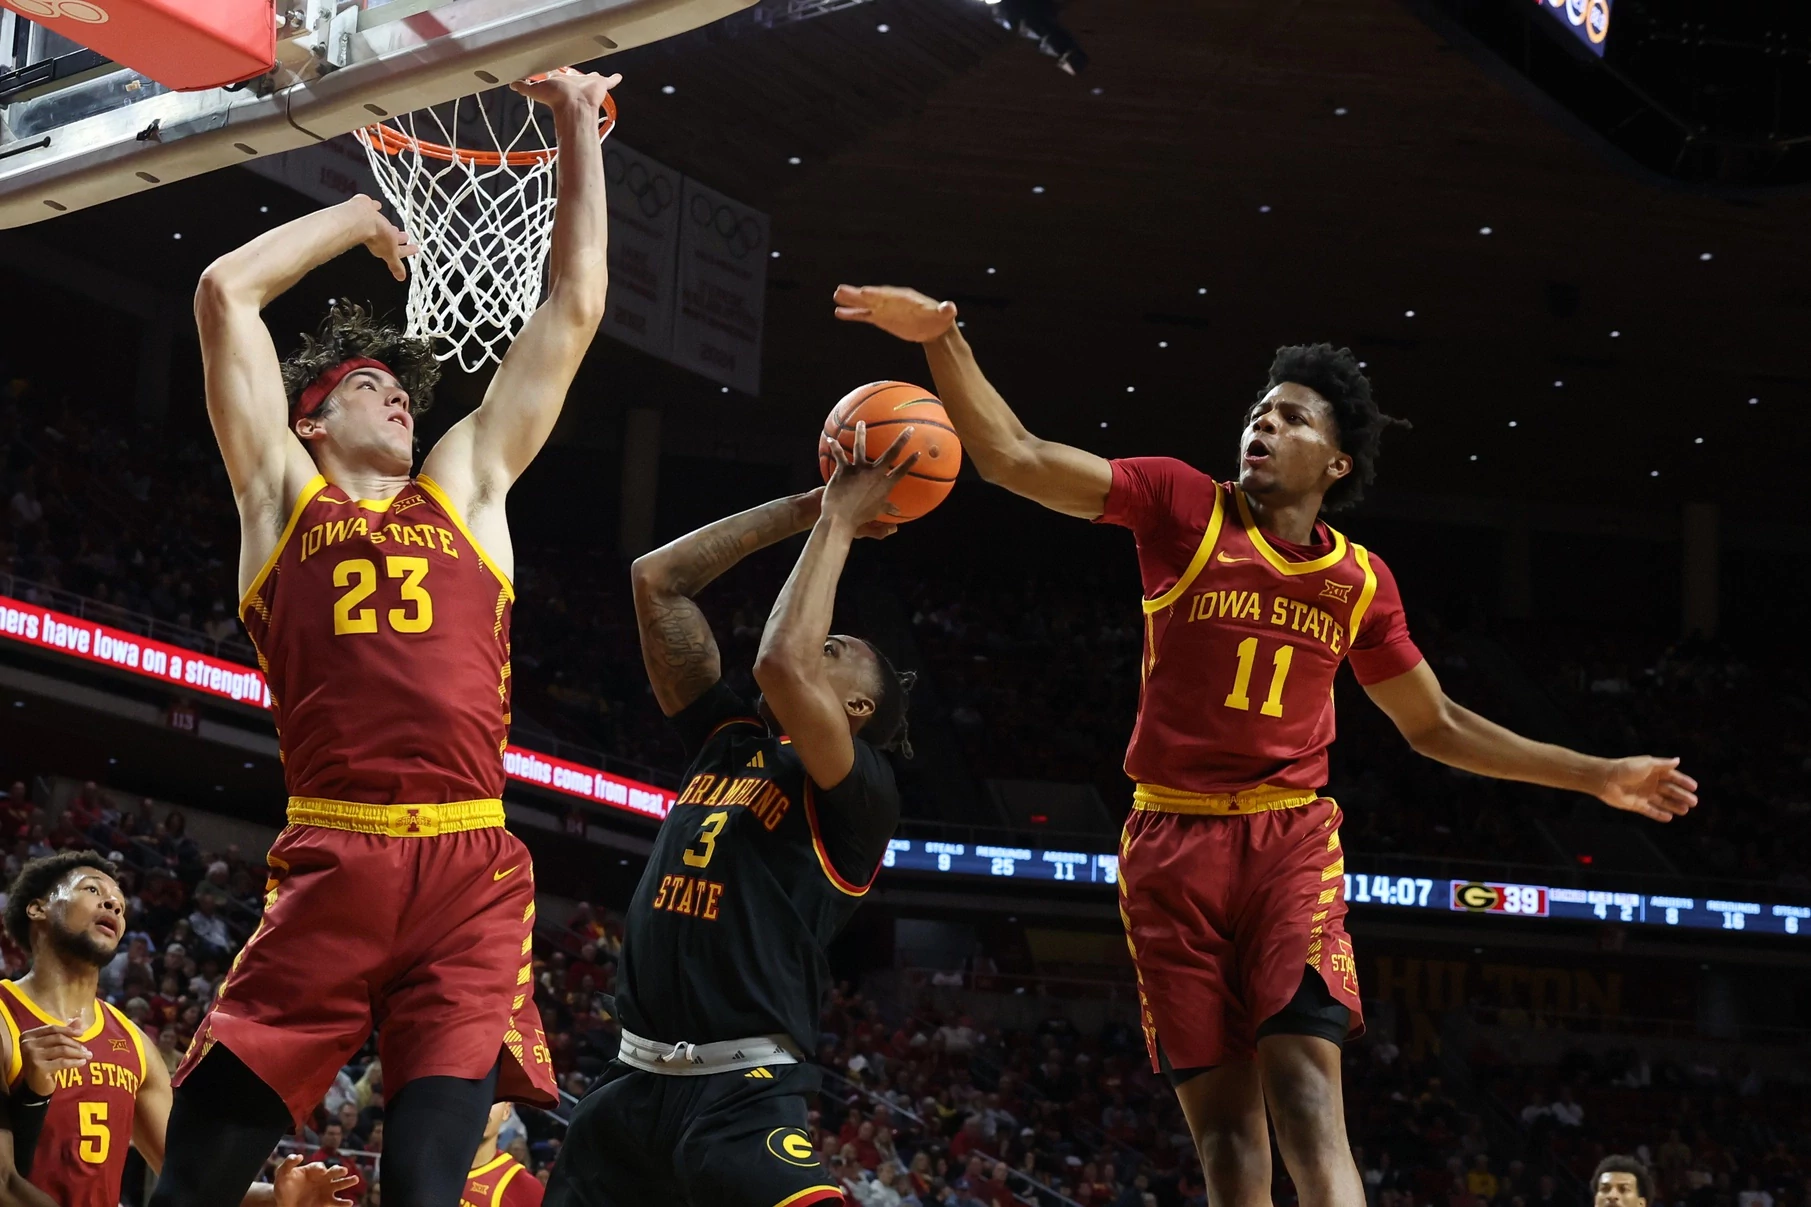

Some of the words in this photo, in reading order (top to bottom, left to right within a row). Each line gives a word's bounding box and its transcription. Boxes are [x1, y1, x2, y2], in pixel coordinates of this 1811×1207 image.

[301, 517, 368, 562] IOWA
[370, 524, 459, 559] STATE
[333, 556, 433, 635] 23
[1188, 590, 1261, 622] IOWA
[1271, 597, 1343, 655] STATE
[42, 613, 90, 654] have
[93, 628, 139, 668] Iowa
[142, 648, 167, 676] on
[169, 656, 182, 679] a
[185, 659, 261, 702] strength
[1224, 637, 1294, 718] 11
[553, 767, 592, 796] come
[594, 773, 627, 806] from
[628, 787, 666, 819] meat,
[675, 772, 791, 833] GRAMBLING
[683, 810, 729, 869] 3
[883, 850, 896, 868] 3
[938, 853, 951, 871] 9
[991, 858, 1015, 876] 25
[1054, 862, 1076, 880] 11
[925, 842, 965, 856] STEALS
[652, 872, 725, 922] STATE
[1355, 873, 1433, 908] 14:07
[1503, 886, 1539, 915] 39
[55, 1066, 82, 1089] WA
[78, 1102, 110, 1163] 5
